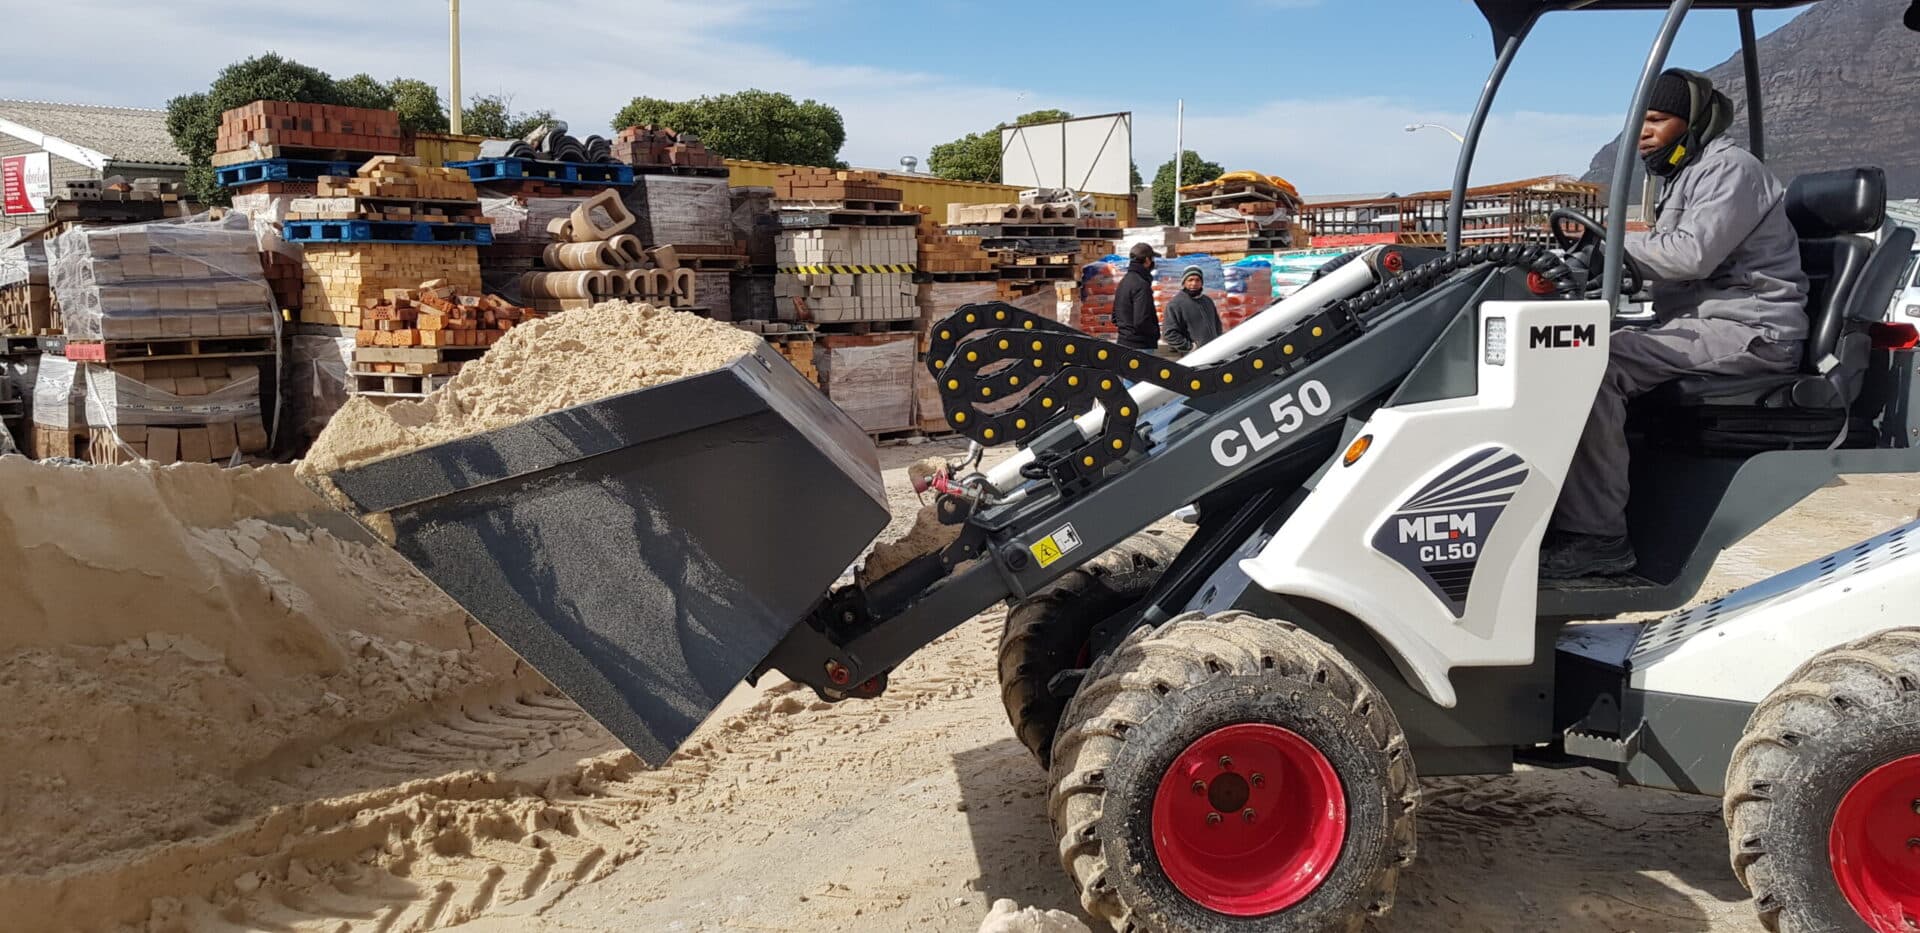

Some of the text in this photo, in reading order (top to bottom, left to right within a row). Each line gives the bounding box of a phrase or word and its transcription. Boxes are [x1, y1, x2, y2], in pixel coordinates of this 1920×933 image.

[1529, 324, 1595, 348] MCM
[1210, 380, 1331, 467] CL50
[1398, 512, 1476, 543] MCM
[1420, 542, 1476, 562] CL50
